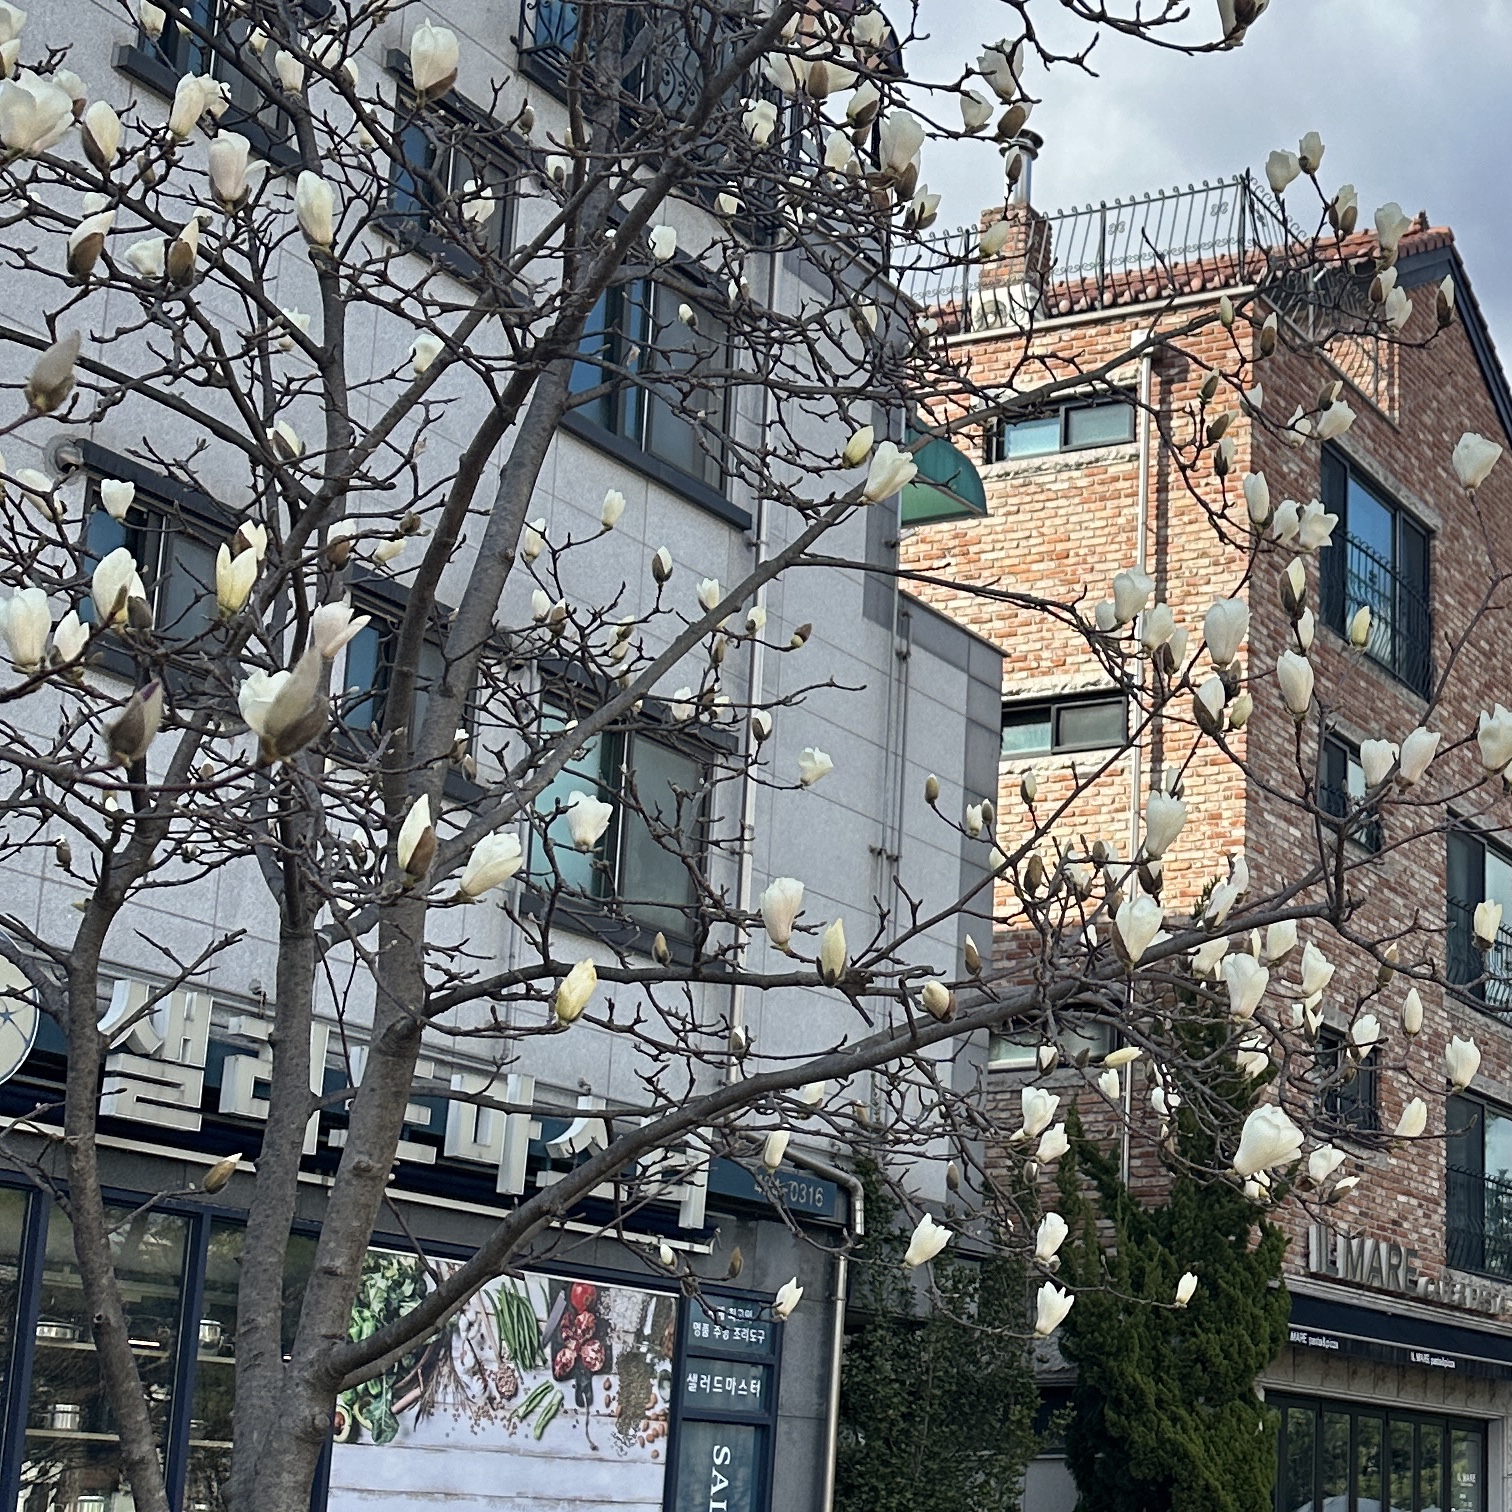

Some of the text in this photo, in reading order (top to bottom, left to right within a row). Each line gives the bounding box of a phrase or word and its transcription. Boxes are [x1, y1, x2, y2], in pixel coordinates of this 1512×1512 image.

[1336, 1234, 1417, 1293] MARE
[733, 1327, 765, 1344] 조리도구
[687, 1373, 761, 1397] 샐러드마스터
